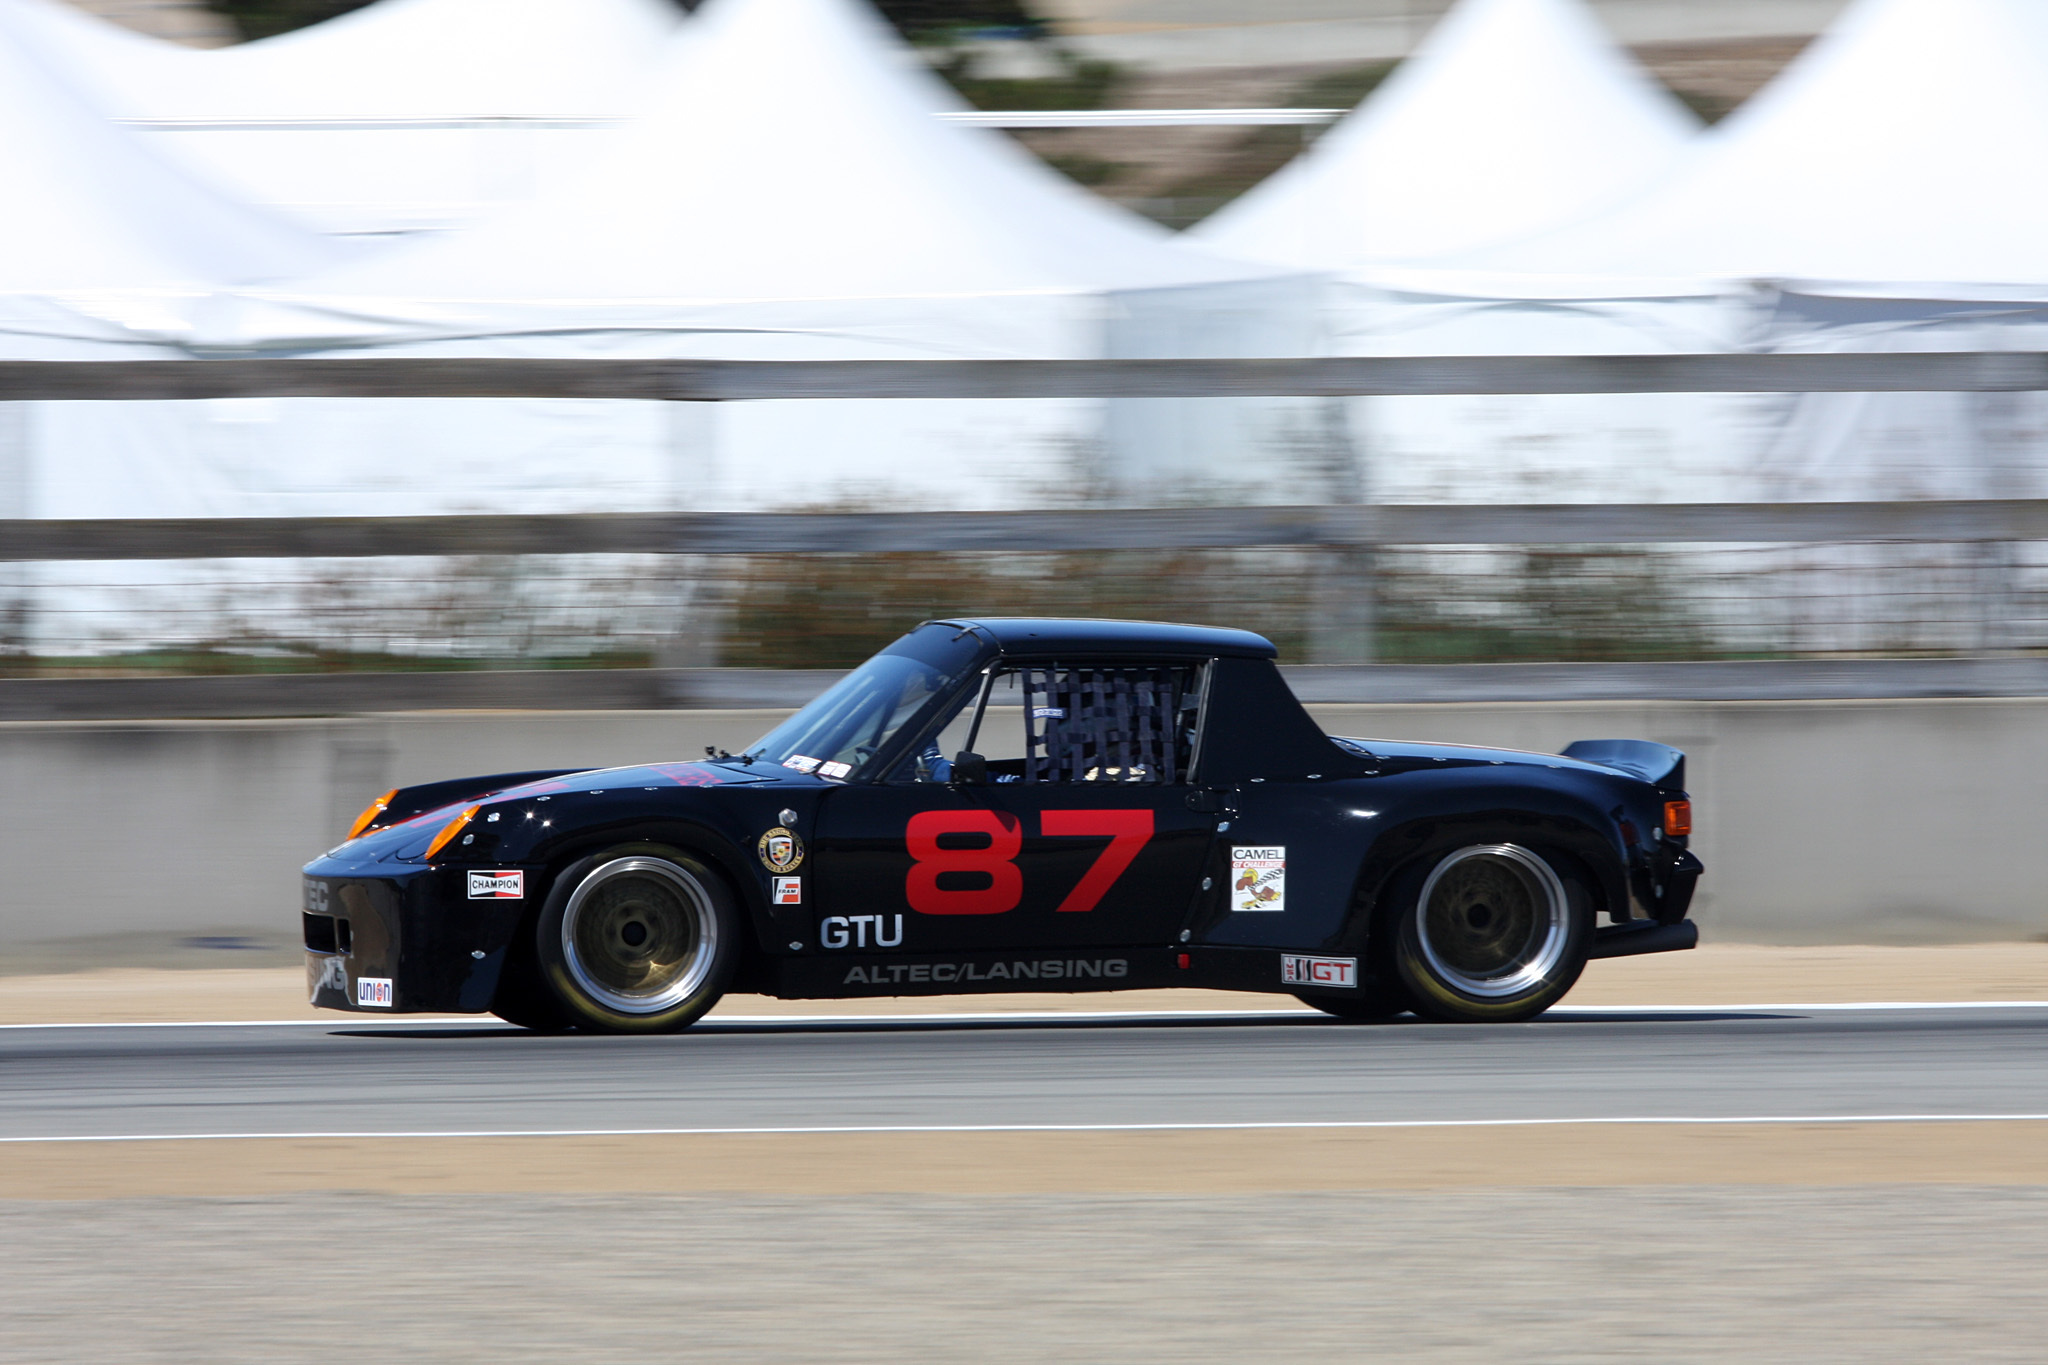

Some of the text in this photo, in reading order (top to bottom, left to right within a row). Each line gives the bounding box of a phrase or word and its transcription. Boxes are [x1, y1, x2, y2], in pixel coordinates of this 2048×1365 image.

[905, 809, 1154, 915] 87
[1233, 849, 1284, 860] CAMEL
[472, 879, 519, 889] CHAMPION
[820, 914, 903, 949] GTU
[843, 958, 1128, 985] ALTEC/LANSING
[1313, 962, 1352, 981] GT
[359, 982, 391, 1002] UNION
